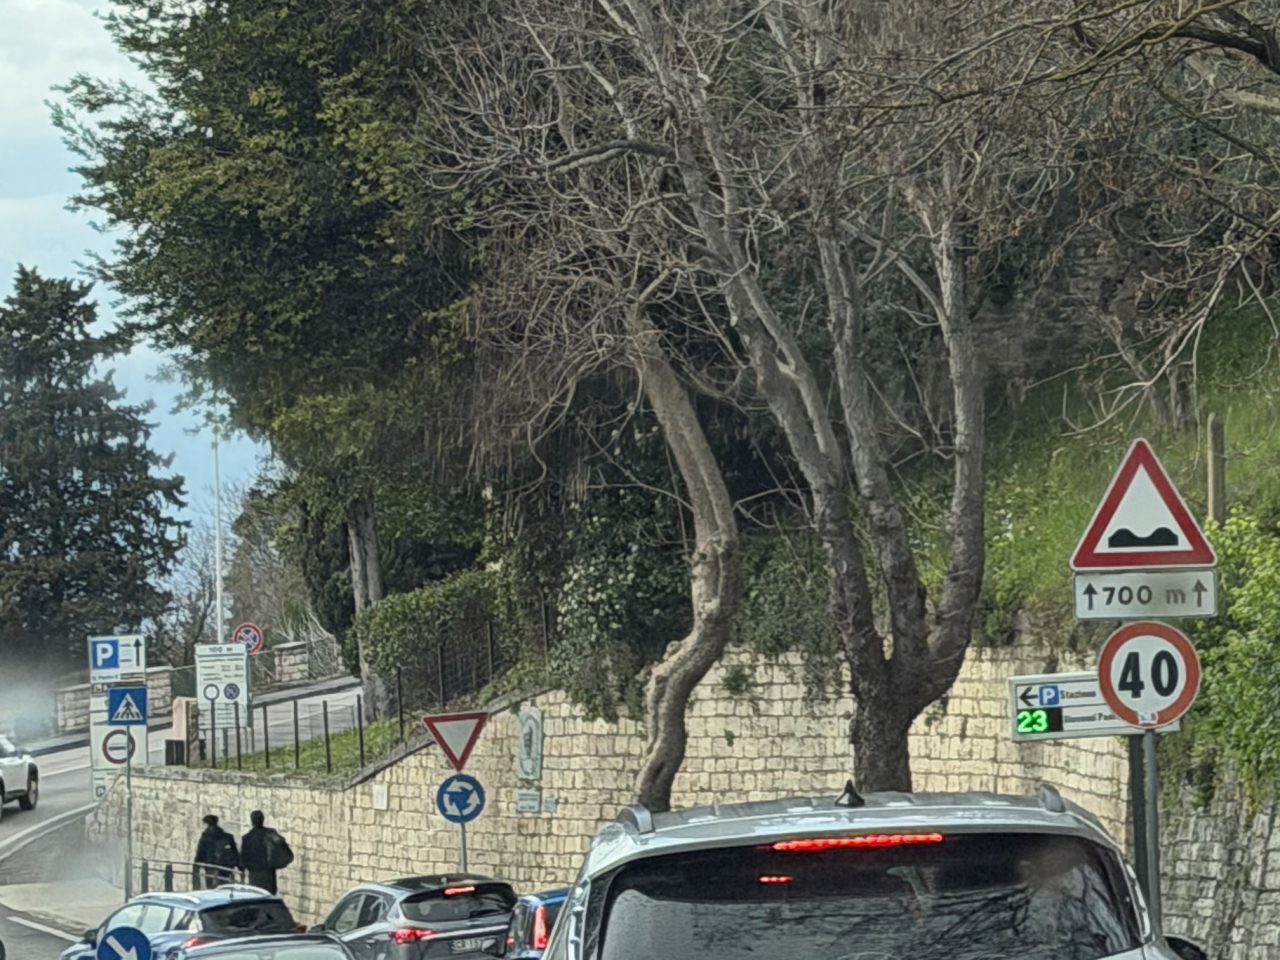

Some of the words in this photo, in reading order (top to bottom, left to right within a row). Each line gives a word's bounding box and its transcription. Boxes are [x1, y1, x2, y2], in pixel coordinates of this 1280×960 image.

[1102, 585, 1154, 606] 700
[1165, 588, 1187, 605] m
[96, 643, 114, 667] P
[1118, 650, 1179, 699] 40
[1042, 687, 1056, 705] P
[1017, 709, 1049, 733] 23
